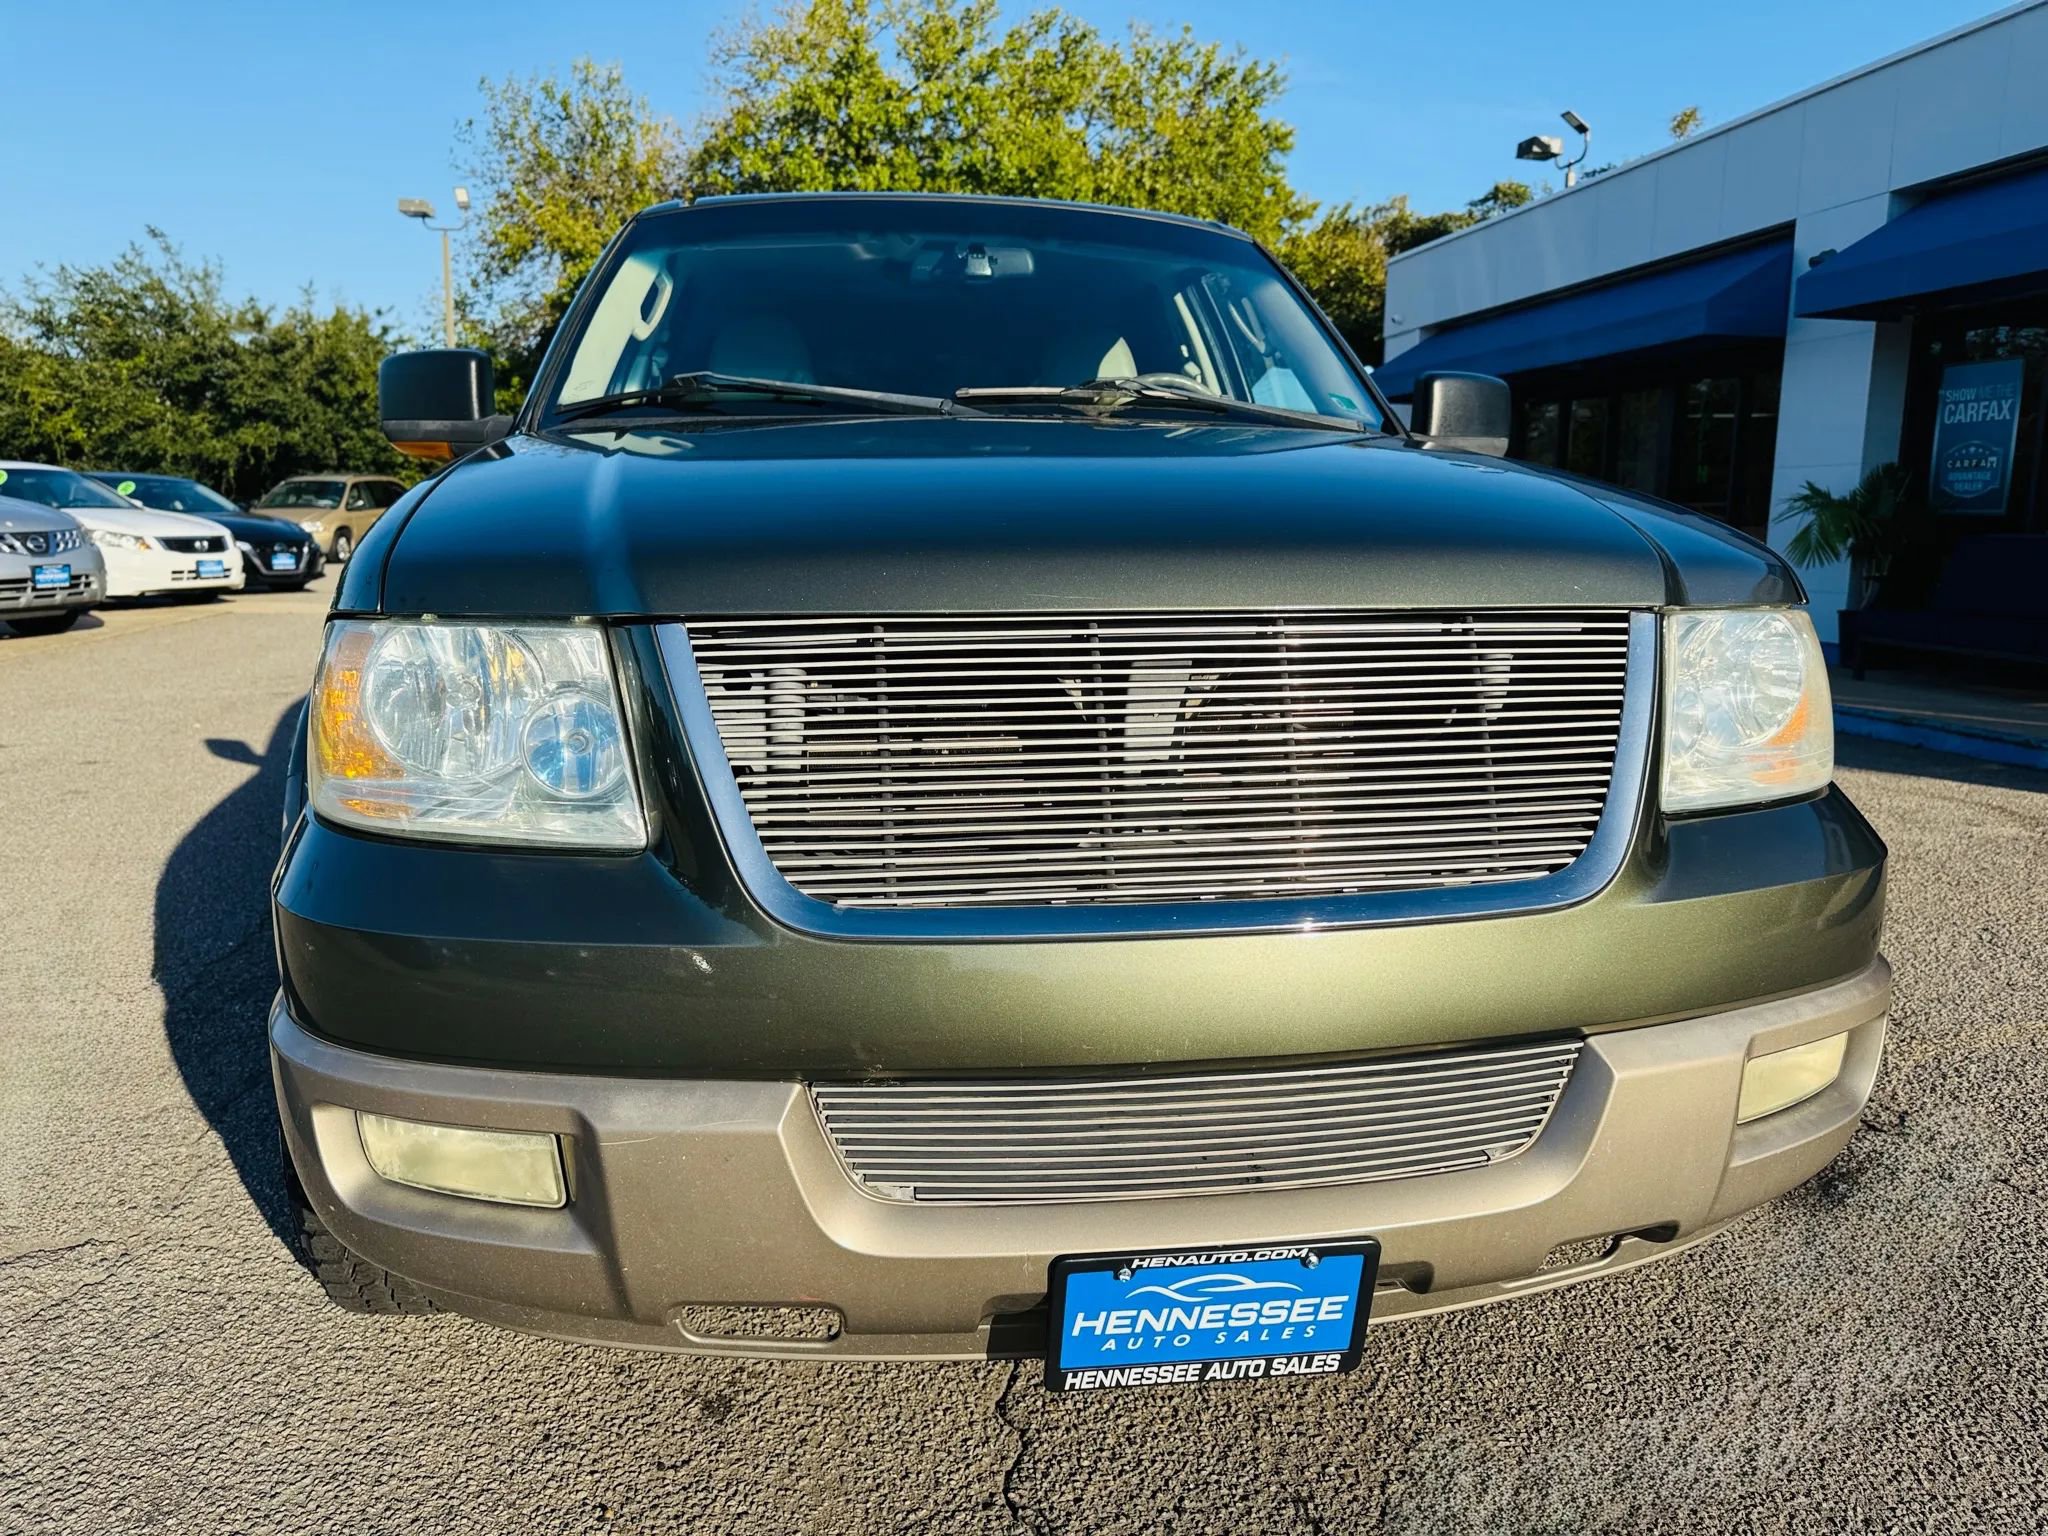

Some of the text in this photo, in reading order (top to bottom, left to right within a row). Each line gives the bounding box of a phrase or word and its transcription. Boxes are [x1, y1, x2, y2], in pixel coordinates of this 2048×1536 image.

[1945, 388, 1977, 402] SHOW
[1944, 399, 2013, 424] CARFAX
[1131, 1247, 1309, 1269] HENAUTO.COM
[1071, 1295, 1350, 1337] HENNESSEE
[1100, 1324, 1317, 1352] AUTO SALES
[1064, 1353, 1341, 1391] HENNESSEE AUTO SALES
